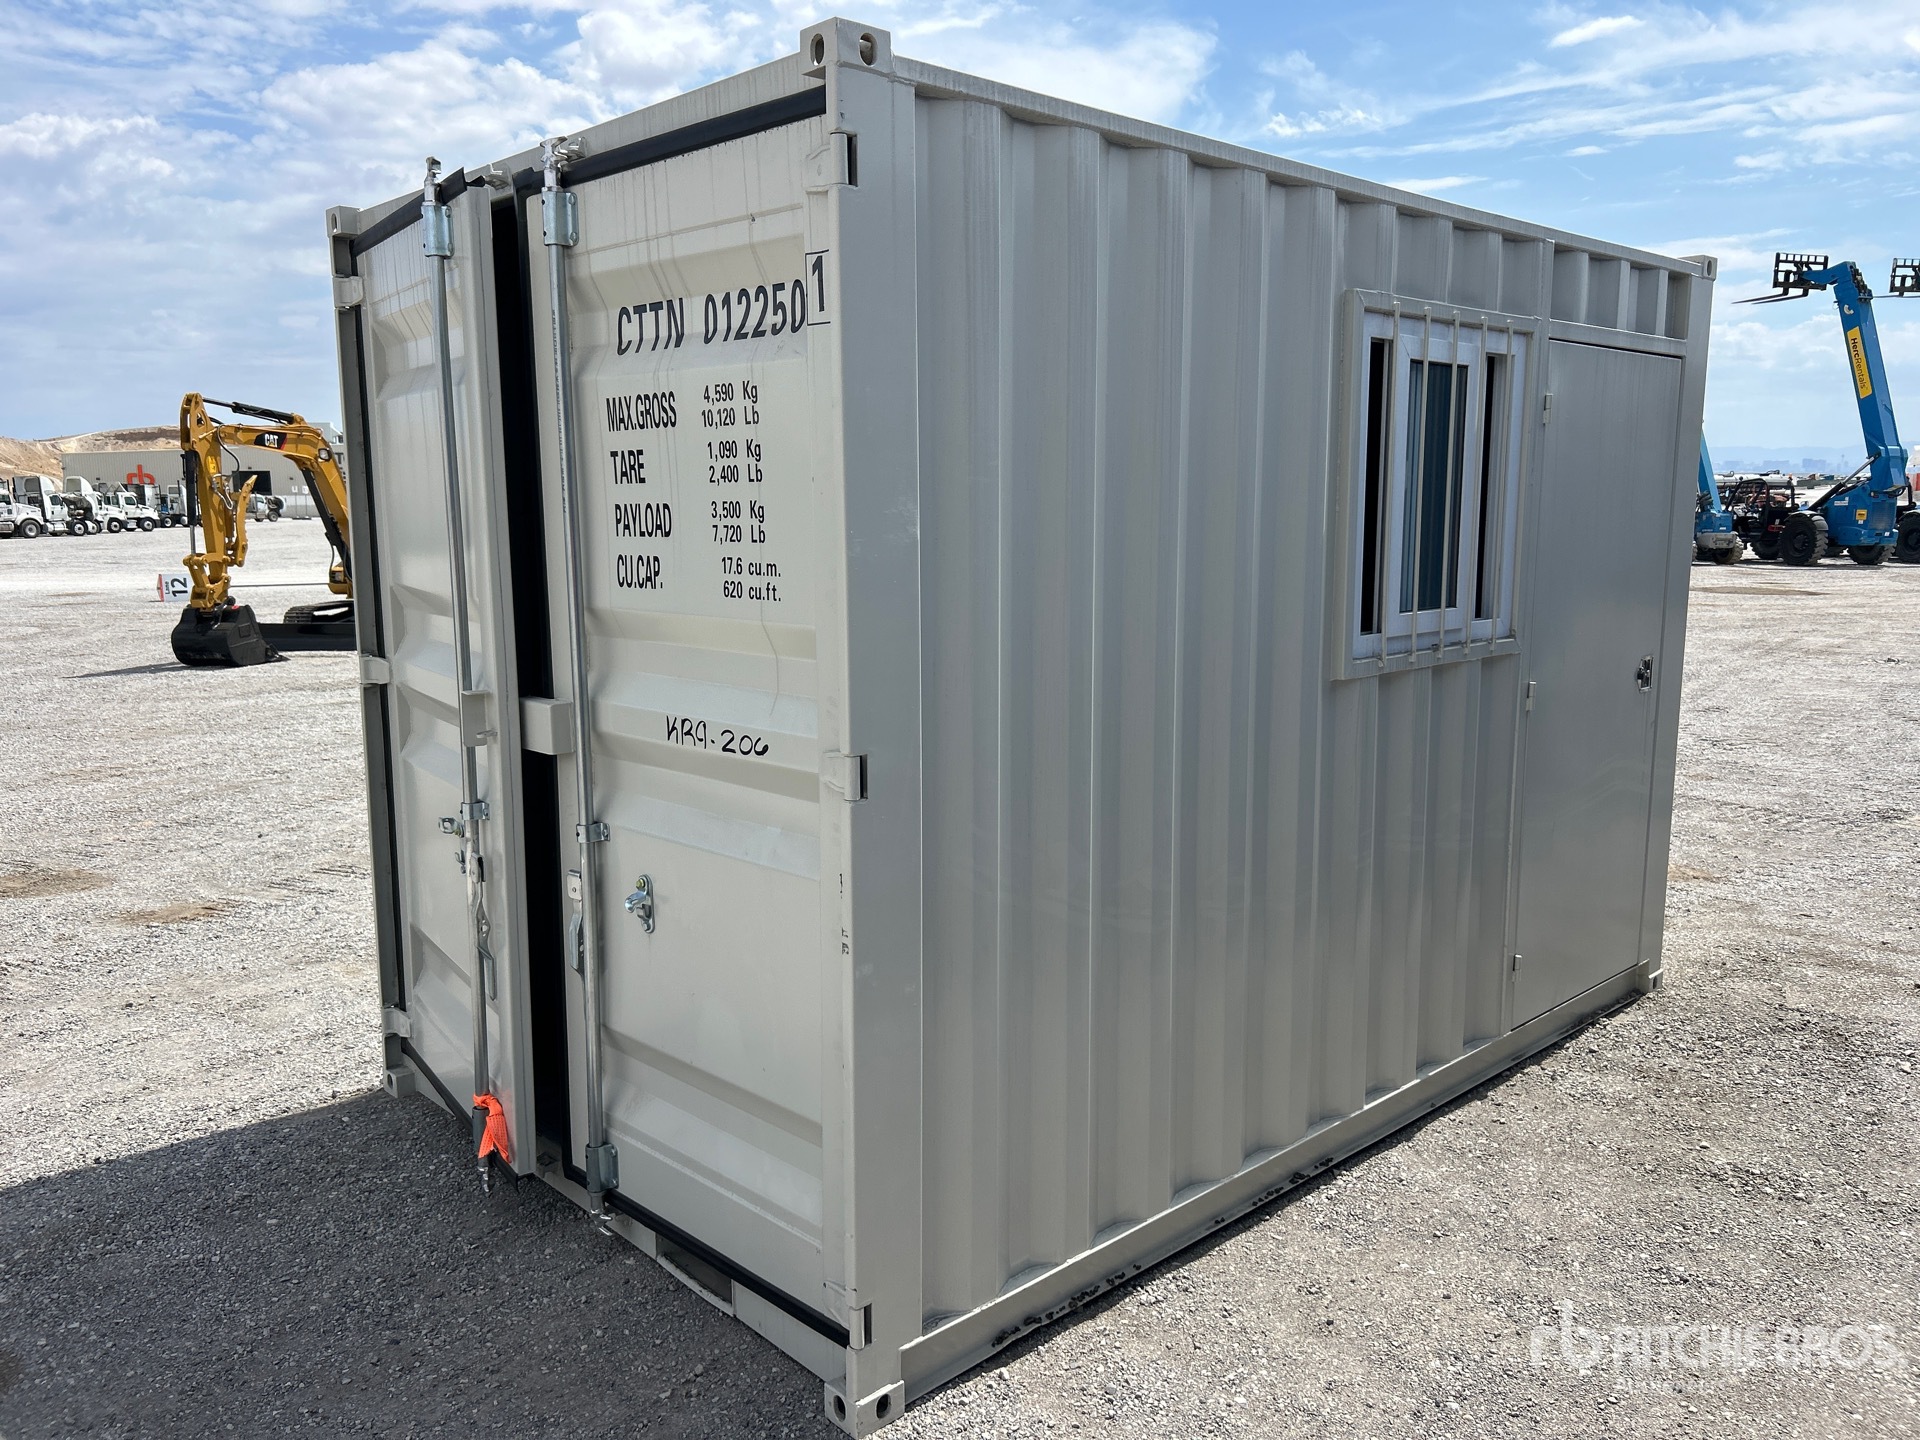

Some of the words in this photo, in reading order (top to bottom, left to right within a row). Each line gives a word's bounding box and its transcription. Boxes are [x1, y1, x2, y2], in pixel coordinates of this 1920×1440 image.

[617, 297, 685, 356] CTTN
[703, 279, 806, 345] 012250
[811, 255, 826, 313] 1
[606, 391, 677, 432] MAX.GROSS
[703, 383, 734, 405] 4,590
[742, 380, 758, 404] Kg
[701, 407, 736, 429] 10,120
[743, 405, 760, 425] Lb
[265, 433, 279, 448] CAT
[610, 449, 646, 484] TARE
[707, 440, 738, 462] 1,090
[746, 439, 761, 462] Kg
[709, 464, 739, 486] 2,400
[747, 463, 763, 483] Lb
[614, 502, 672, 538] PAYLOAD
[711, 501, 741, 521] 3,500
[749, 500, 765, 523] Kg
[712, 525, 742, 545] 7,720
[750, 524, 766, 543] Lb
[616, 554, 663, 589] CU.CAP.
[721, 556, 743, 575] 17.6
[748, 561, 781, 578] cu.m.
[170, 577, 188, 598] 12
[723, 580, 743, 599] 620
[748, 582, 782, 602] cu.ft.
